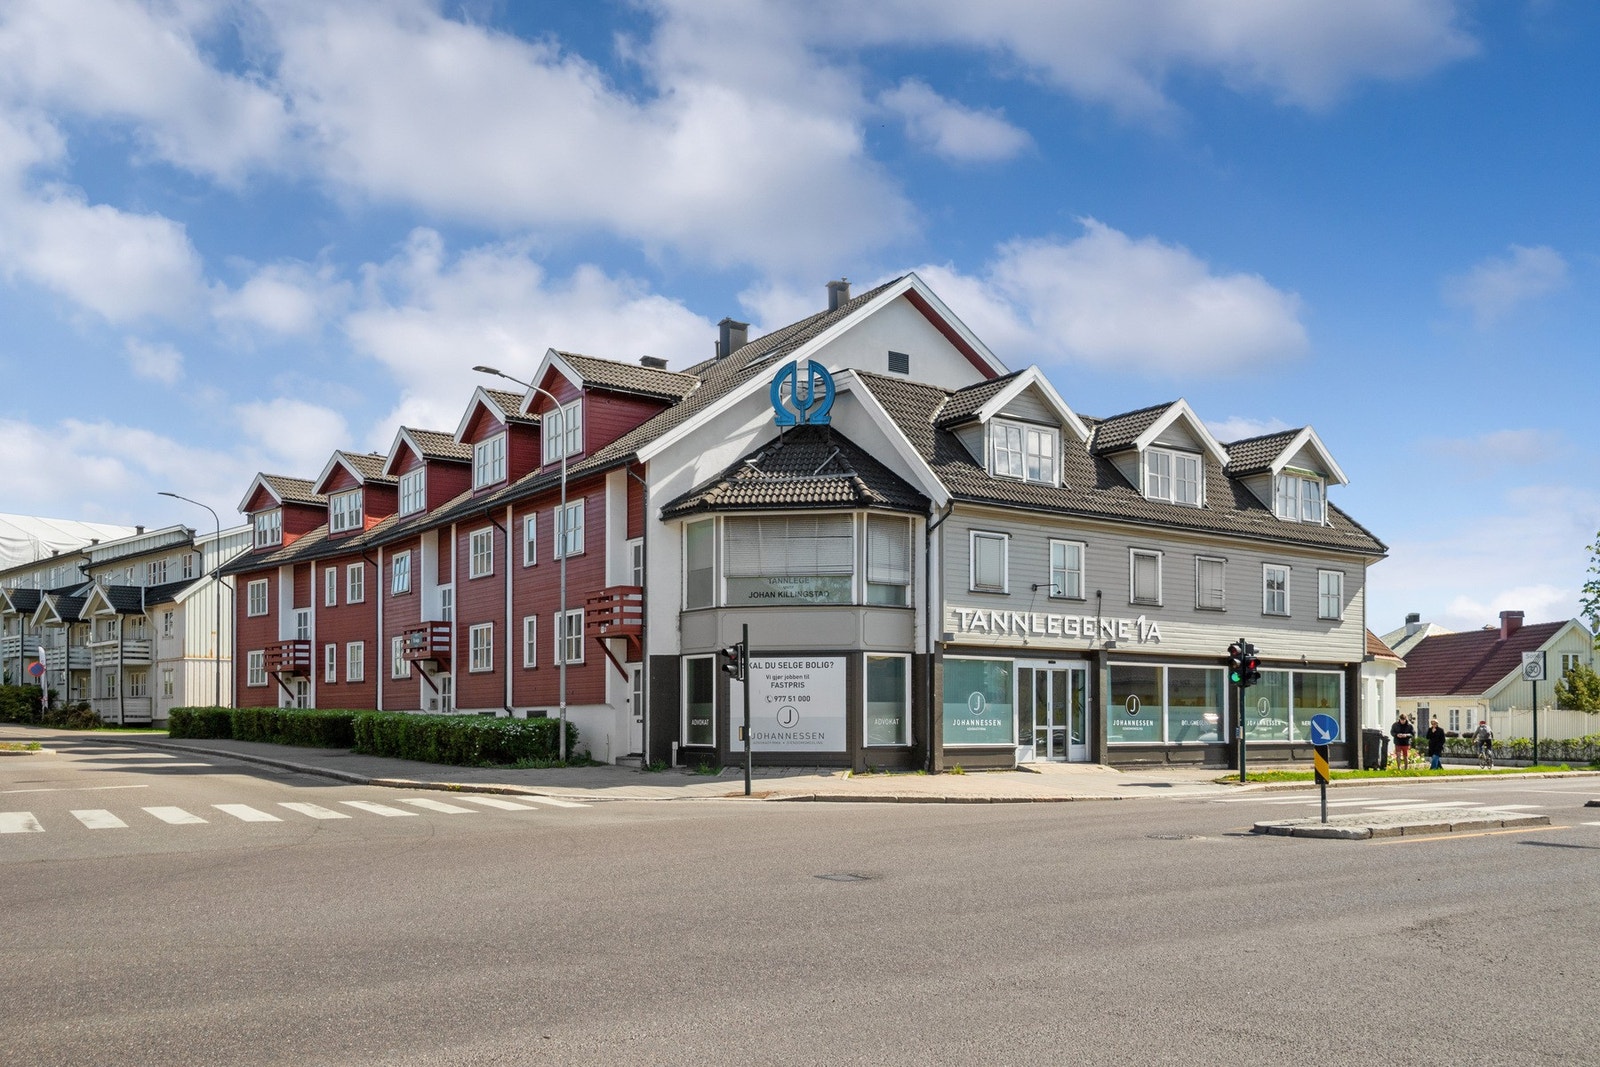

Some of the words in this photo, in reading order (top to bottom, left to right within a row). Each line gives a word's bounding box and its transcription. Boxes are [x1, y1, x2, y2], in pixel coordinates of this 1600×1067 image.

[955, 608, 1132, 640] TANNLEGENE
[778, 661, 803, 669] SELGE
[805, 661, 834, 669] BOLIG?
[1527, 665, 1539, 674] 30
[751, 732, 825, 740] JOHANNESSEN
